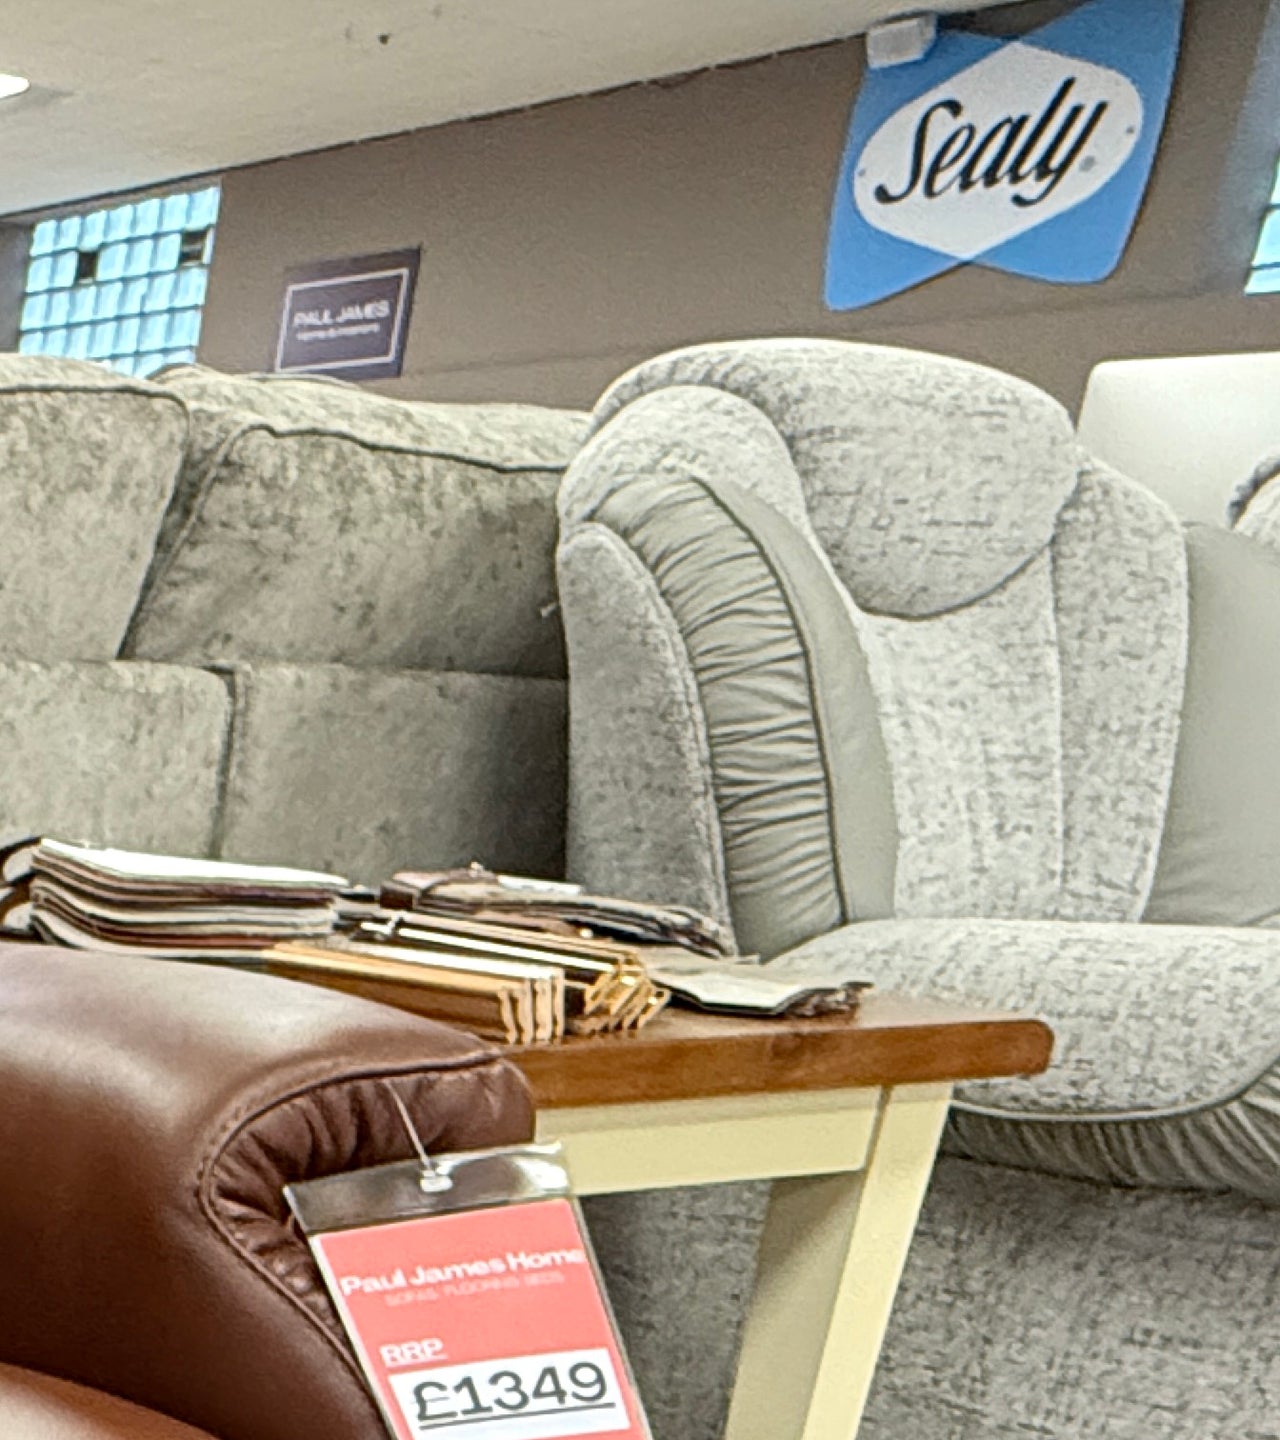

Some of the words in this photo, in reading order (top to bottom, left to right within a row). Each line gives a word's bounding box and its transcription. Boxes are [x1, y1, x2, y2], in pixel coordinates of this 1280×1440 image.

[874, 76, 1108, 207] Sealy
[339, 1268, 406, 1296] Paul
[410, 1257, 506, 1286] James
[379, 1337, 444, 1365] RRP
[412, 1361, 609, 1423] £1349
